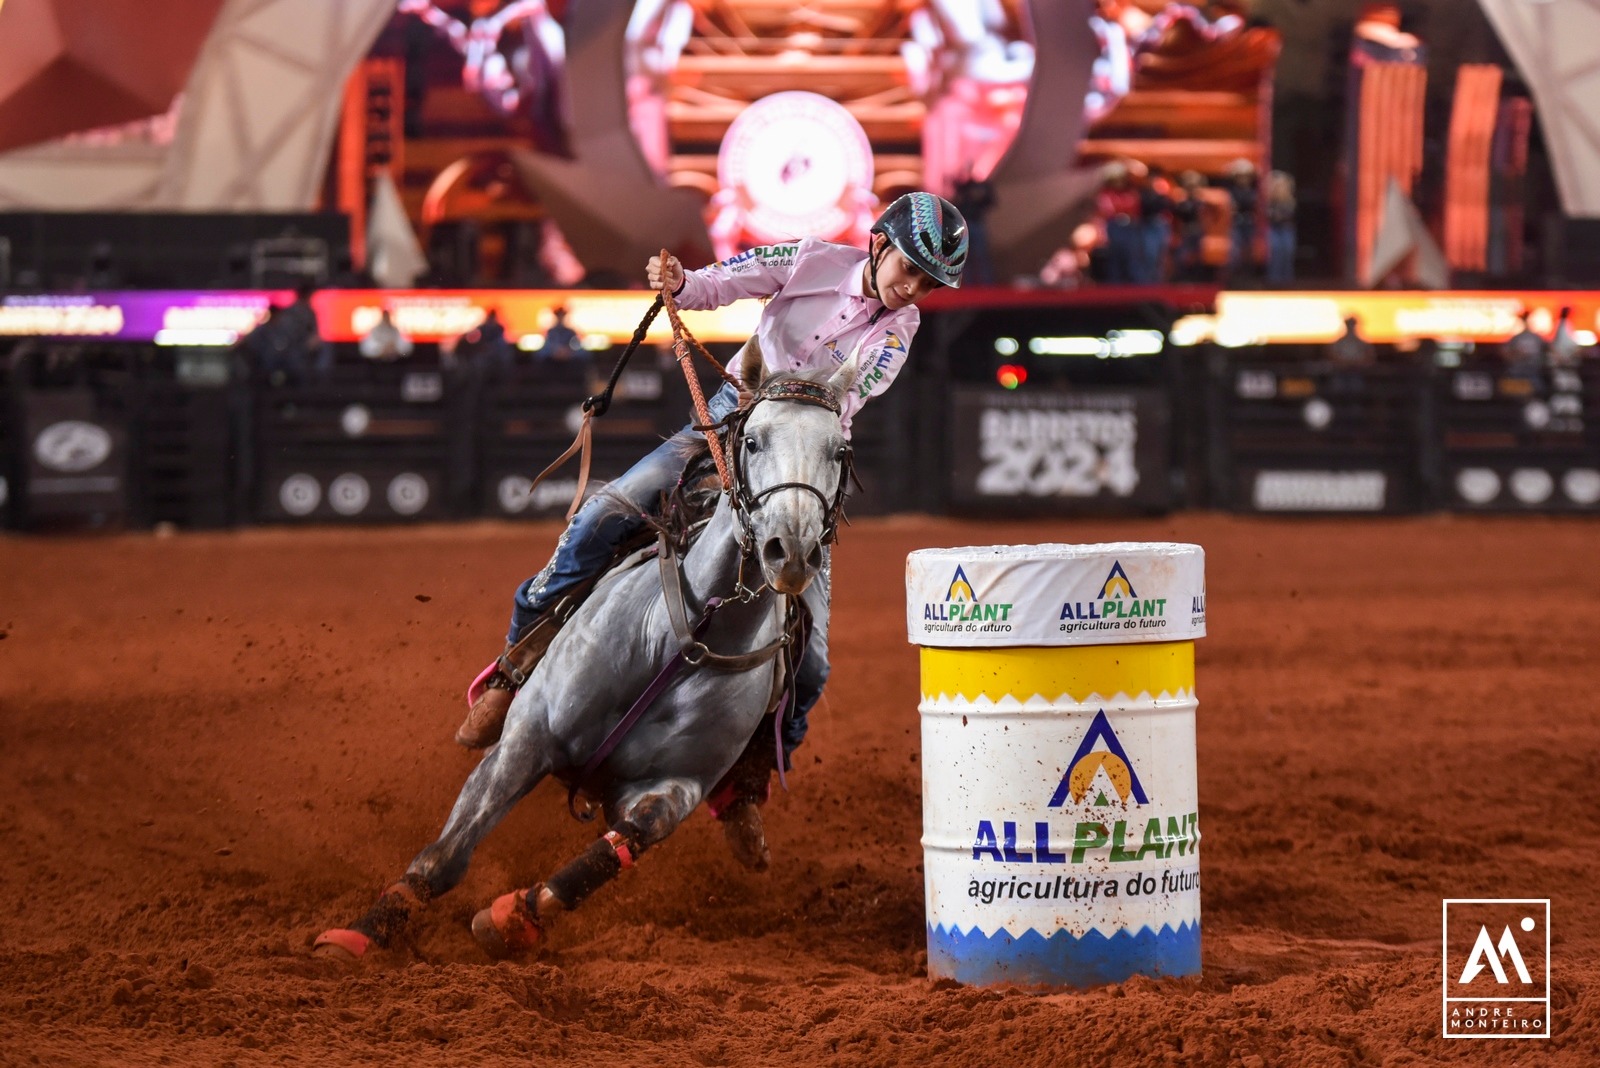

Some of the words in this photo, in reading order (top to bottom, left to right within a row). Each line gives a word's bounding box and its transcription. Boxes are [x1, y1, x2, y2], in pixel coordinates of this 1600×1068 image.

[924, 603, 1013, 621] ALLPLANT
[1060, 599, 1167, 620] ALLPLANT
[924, 622, 963, 633] agricultura
[1059, 621, 1121, 633] agricultura
[1123, 620, 1137, 629] do
[1139, 619, 1167, 628] futuro
[968, 875, 1119, 904] agricultura
[1125, 872, 1157, 897] do
